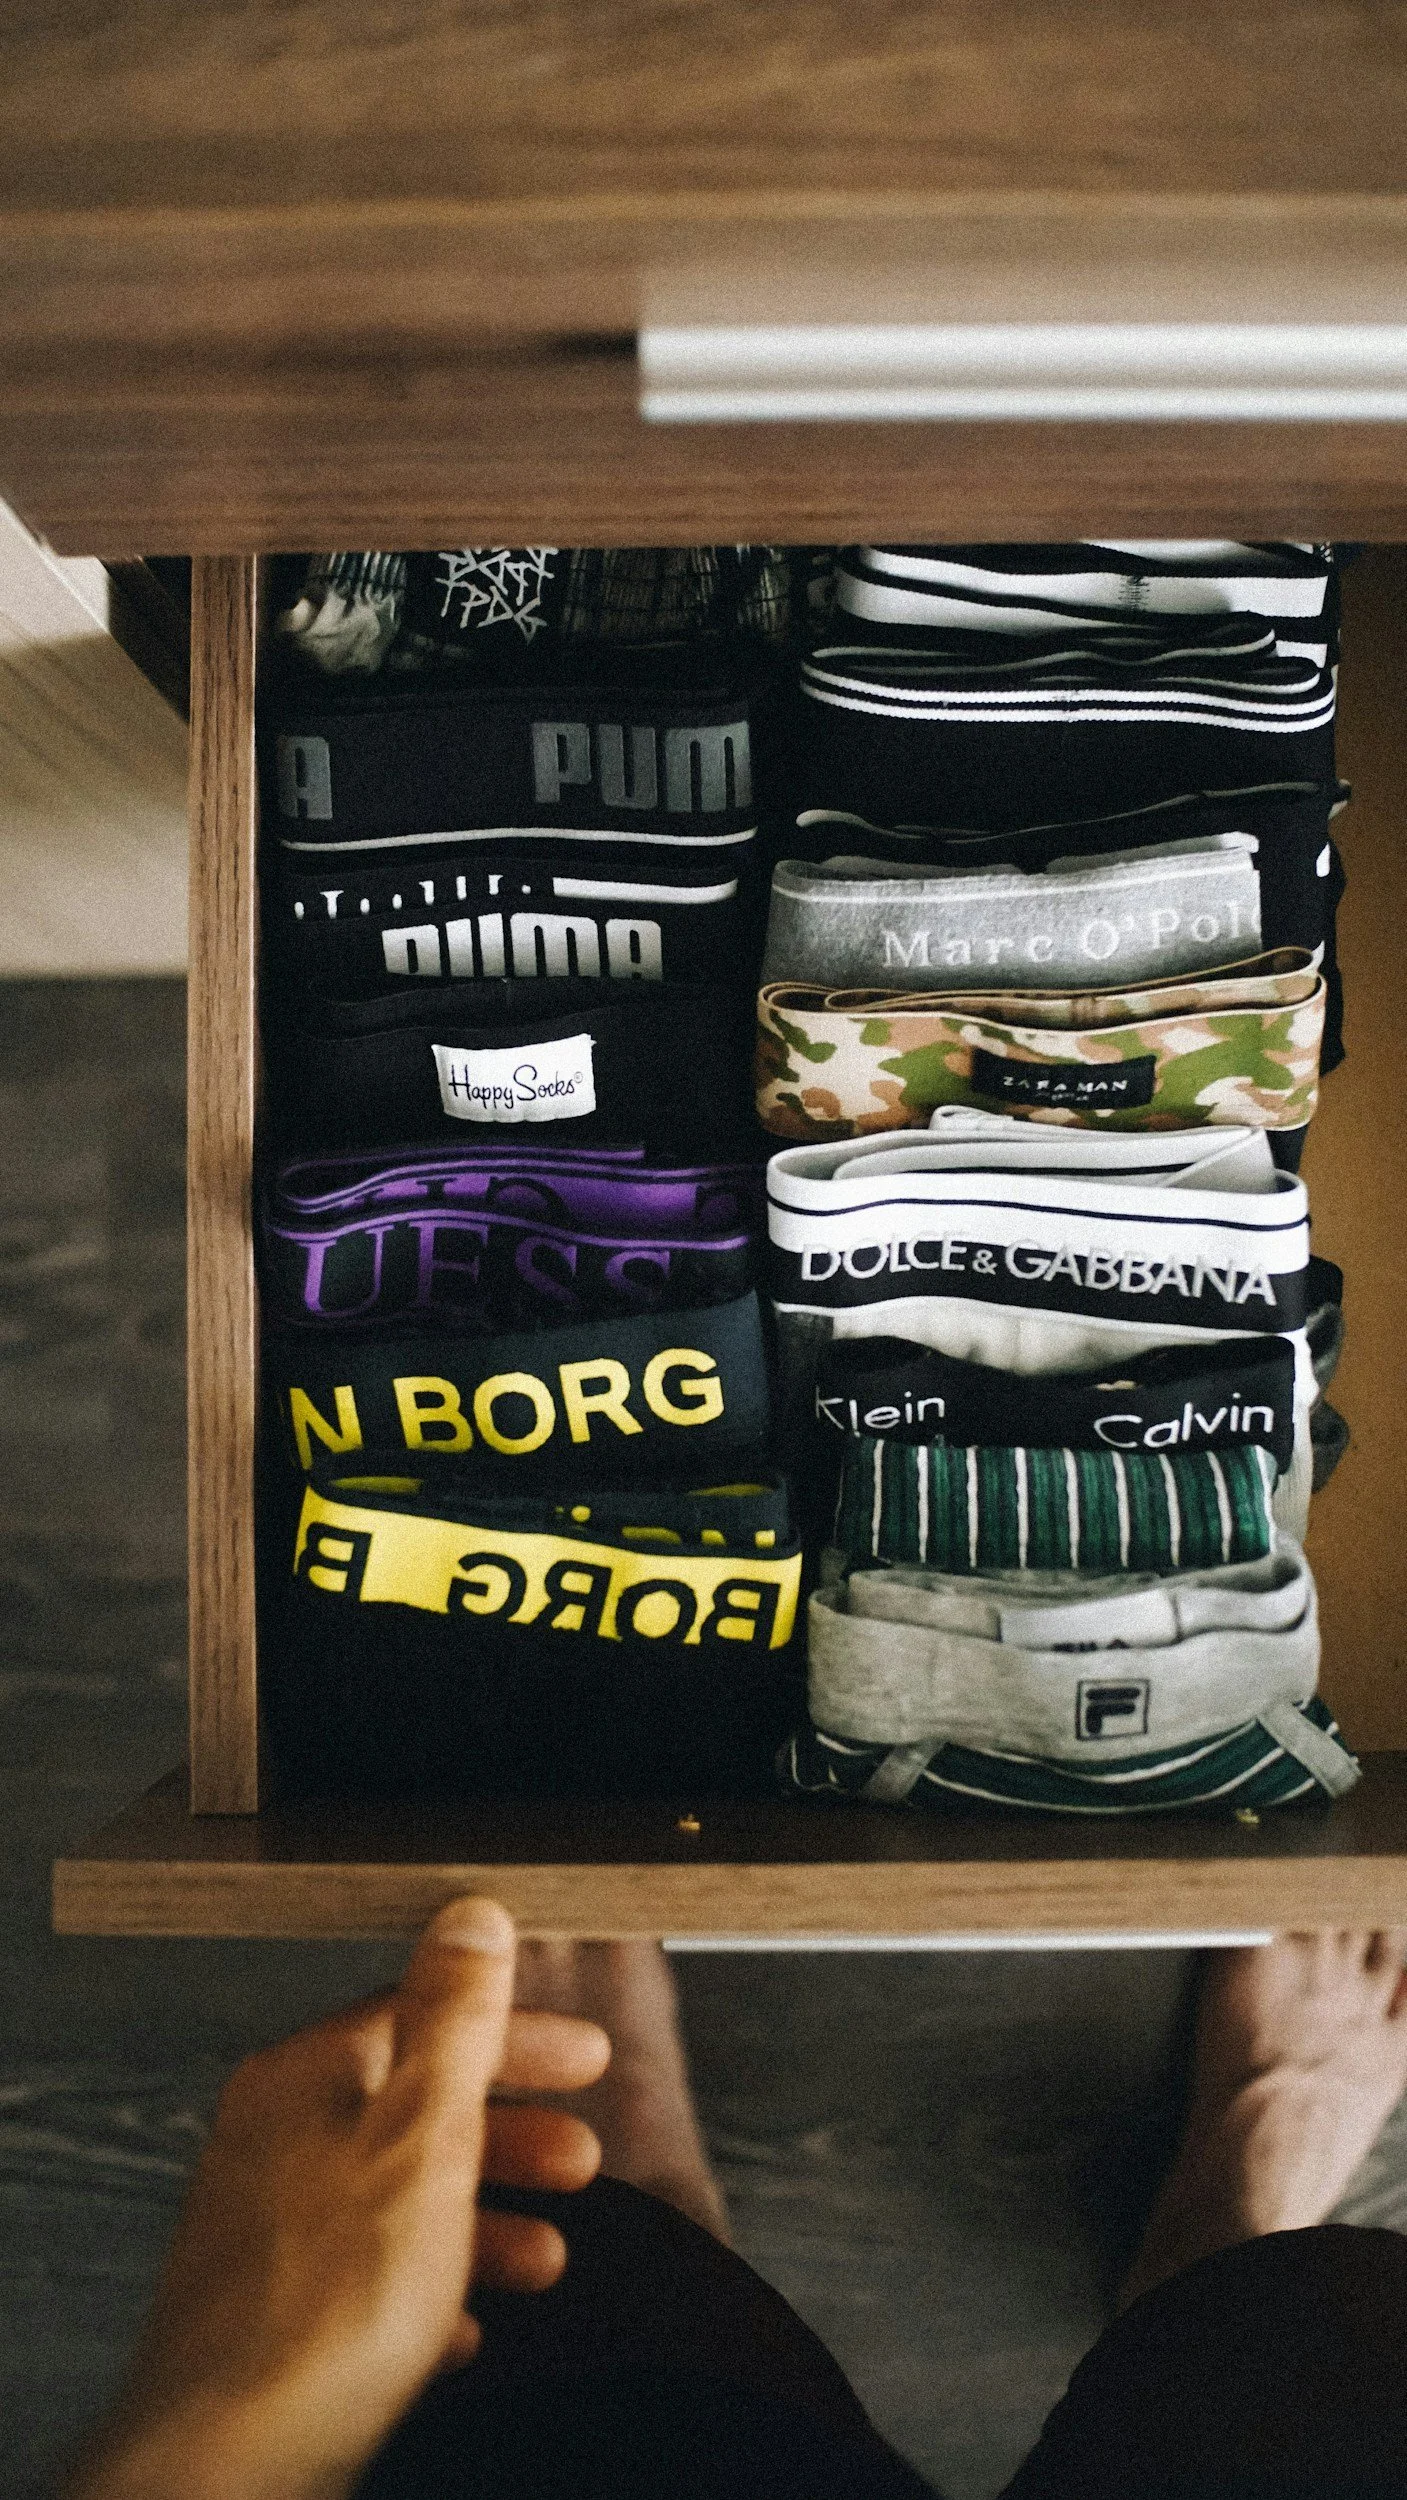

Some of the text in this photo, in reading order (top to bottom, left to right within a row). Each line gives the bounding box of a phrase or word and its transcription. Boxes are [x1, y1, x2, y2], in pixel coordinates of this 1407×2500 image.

[880, 928, 1055, 969] Marc
[449, 1064, 575, 1109] Happy Socks
[1077, 1079, 1128, 1093] MAN
[393, 1348, 725, 1455] BORG
[815, 1388, 1274, 1448] Klein Calvin
